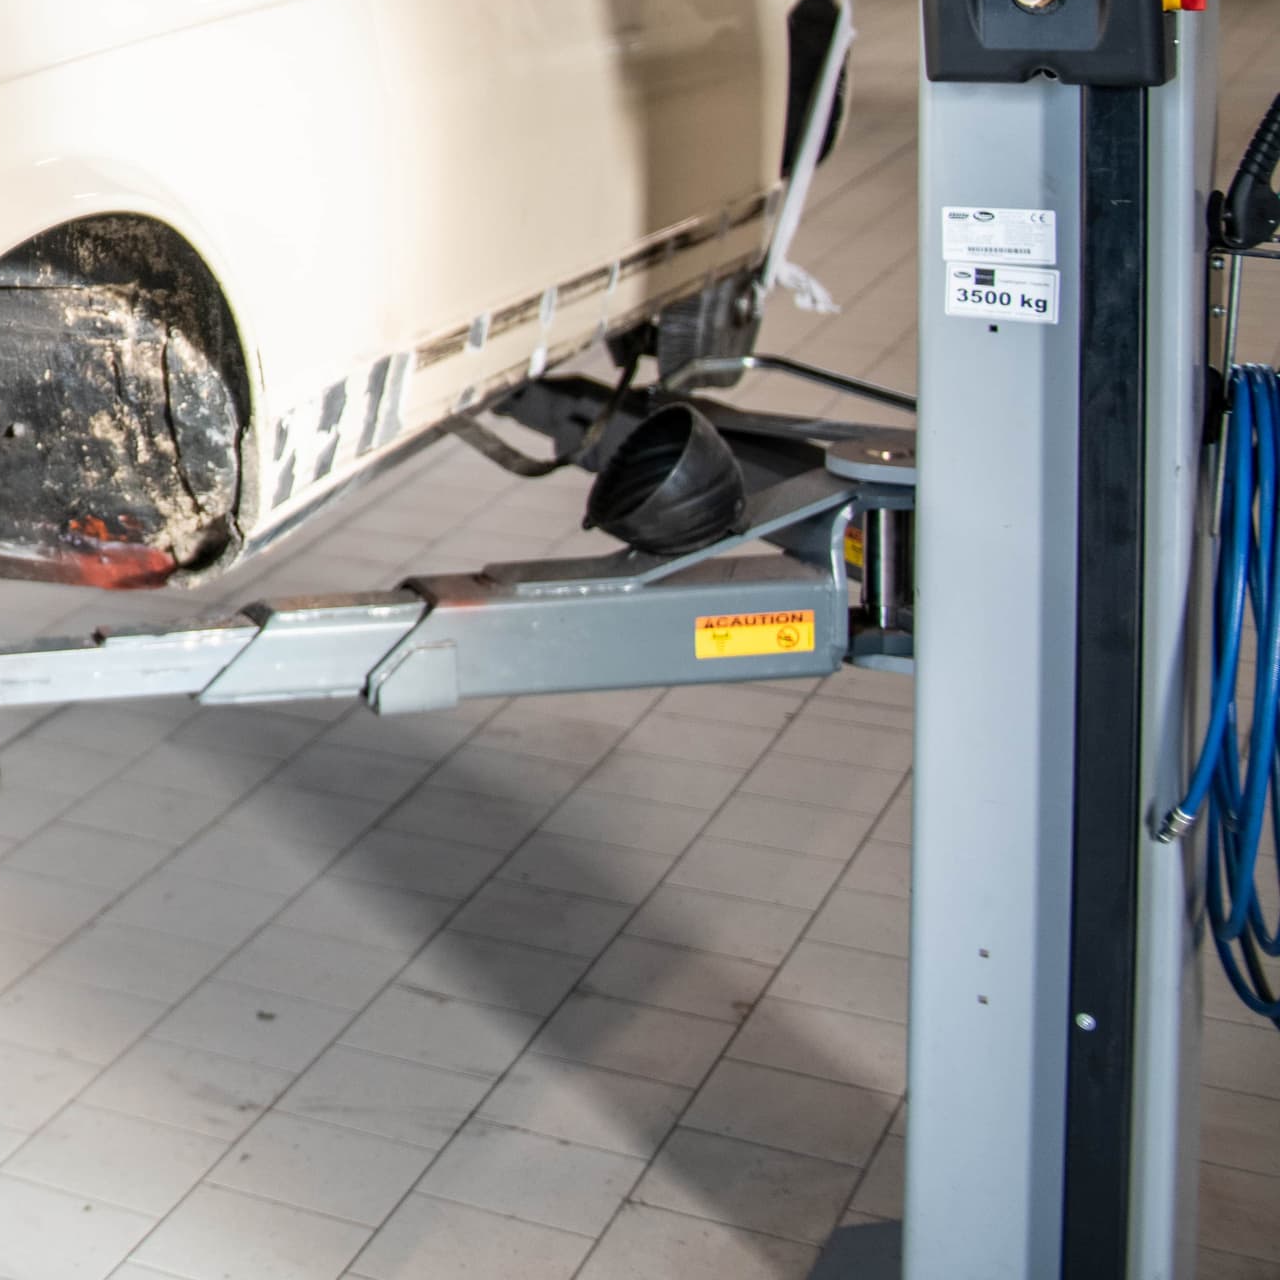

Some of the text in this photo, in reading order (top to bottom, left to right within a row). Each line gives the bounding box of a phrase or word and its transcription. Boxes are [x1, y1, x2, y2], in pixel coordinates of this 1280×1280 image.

[956, 288, 1012, 306] 3500
[1020, 293, 1048, 313] kg
[716, 613, 804, 627] CAUTION
